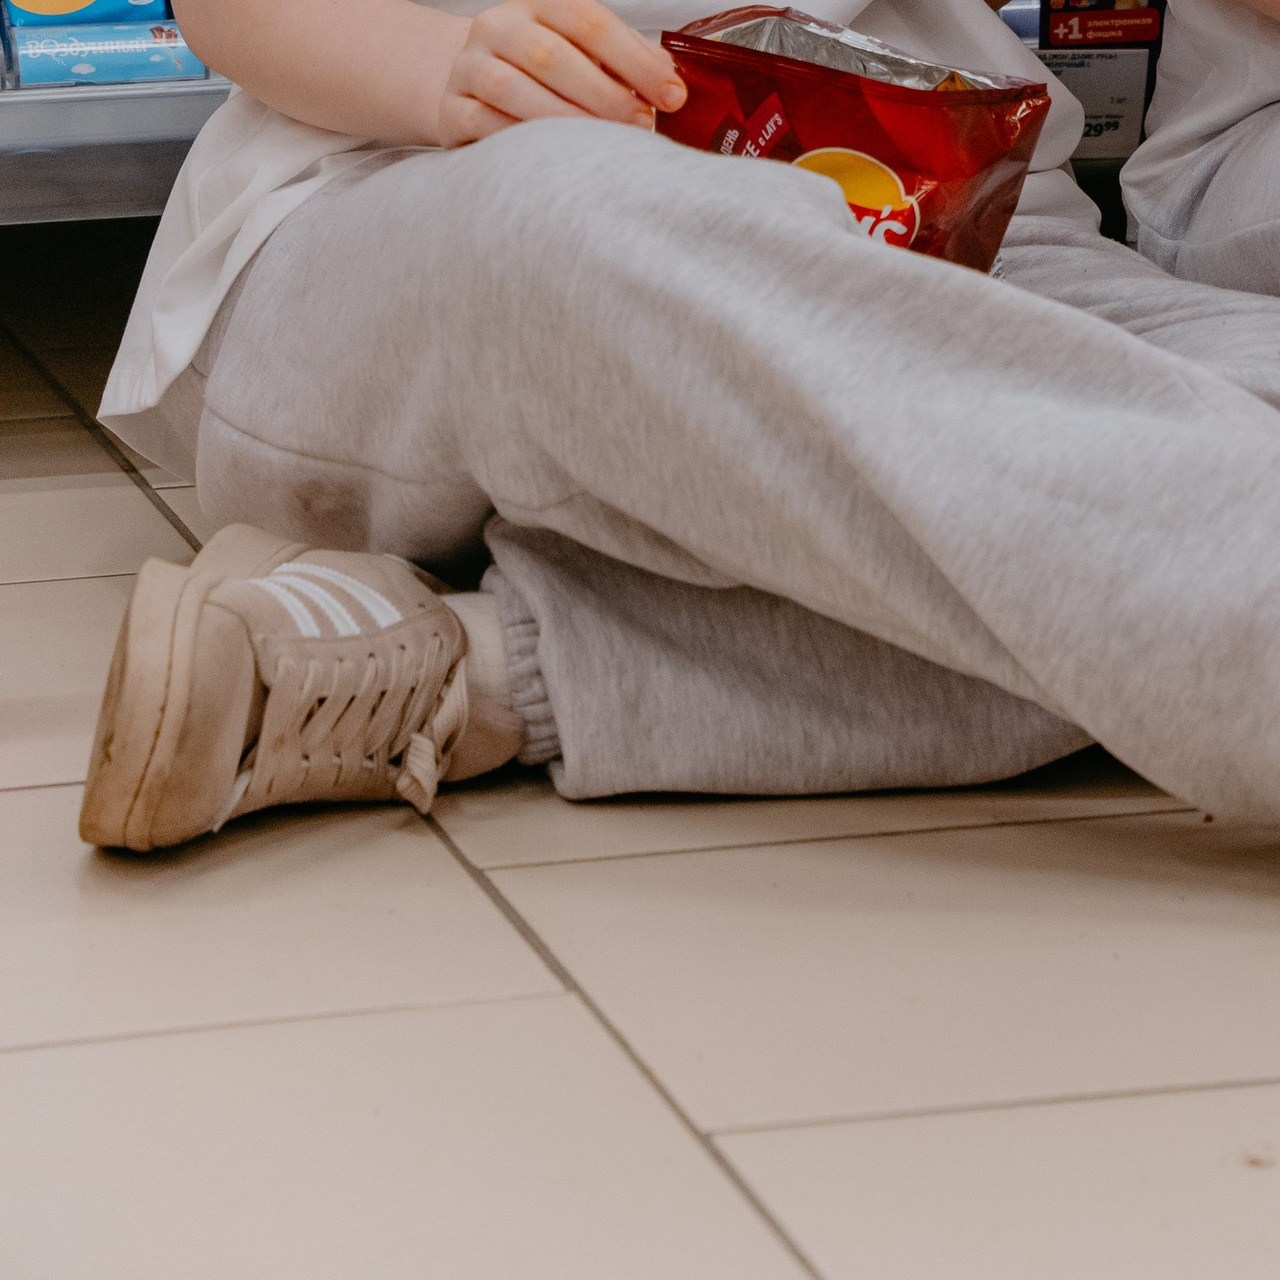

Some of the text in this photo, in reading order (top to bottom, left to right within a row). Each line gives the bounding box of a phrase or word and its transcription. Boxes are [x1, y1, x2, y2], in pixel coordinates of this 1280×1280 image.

[1053, 17, 1083, 40] +1
[1087, 18, 1152, 28] электронная
[1086, 30, 1123, 40] фишка
[761, 113, 784, 141] LAY'S
[720, 129, 740, 156] ДЕНЬ
